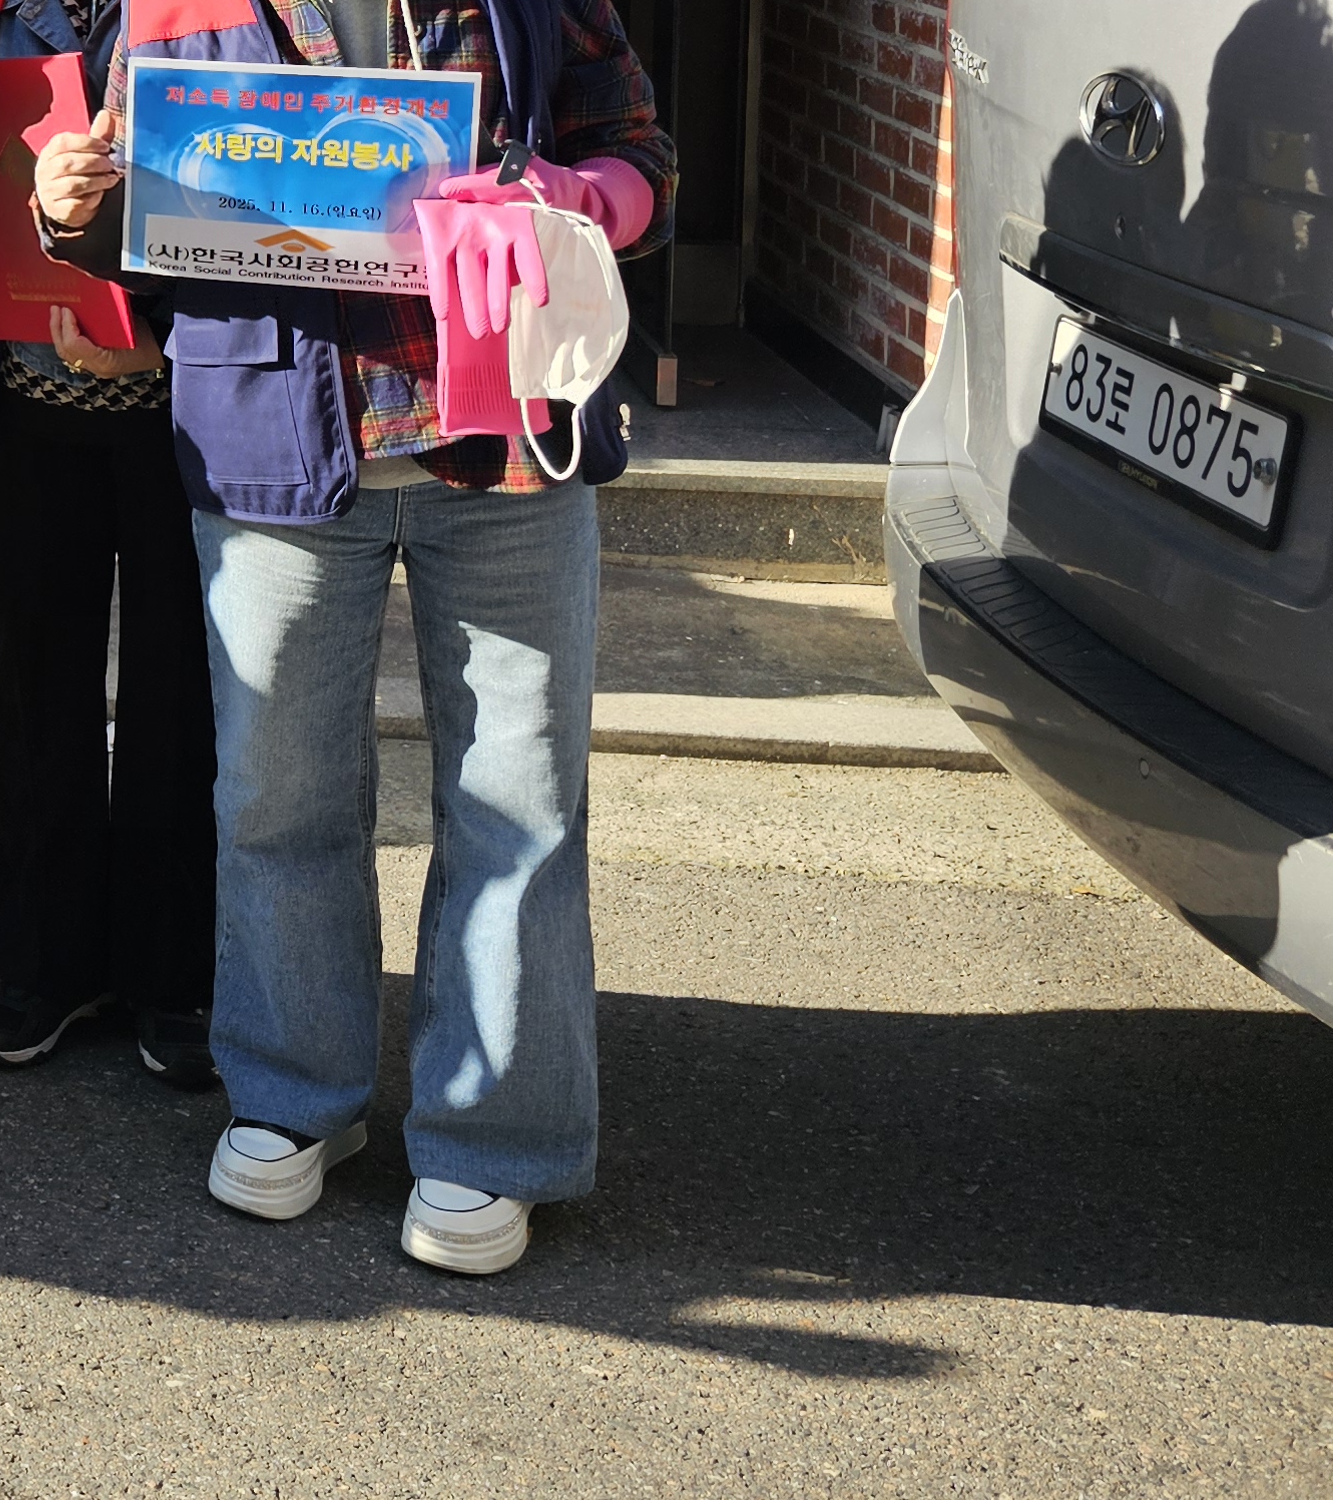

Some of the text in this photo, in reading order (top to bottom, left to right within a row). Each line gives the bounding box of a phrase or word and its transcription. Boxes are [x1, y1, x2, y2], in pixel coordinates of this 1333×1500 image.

[165, 85, 230, 107] 저소득
[237, 89, 303, 112] 장애인
[195, 130, 414, 172] 사랑의 자원봉사
[218, 195, 262, 212] 2025.
[270, 199, 294, 214] 11.
[147, 242, 428, 281] (사)한국사회공헌연구
[148, 261, 186, 272] Korea
[193, 264, 231, 276] Social
[239, 268, 314, 283] Contribution
[320, 275, 382, 289] Research
[1065, 343, 1260, 499] 83로 0875
